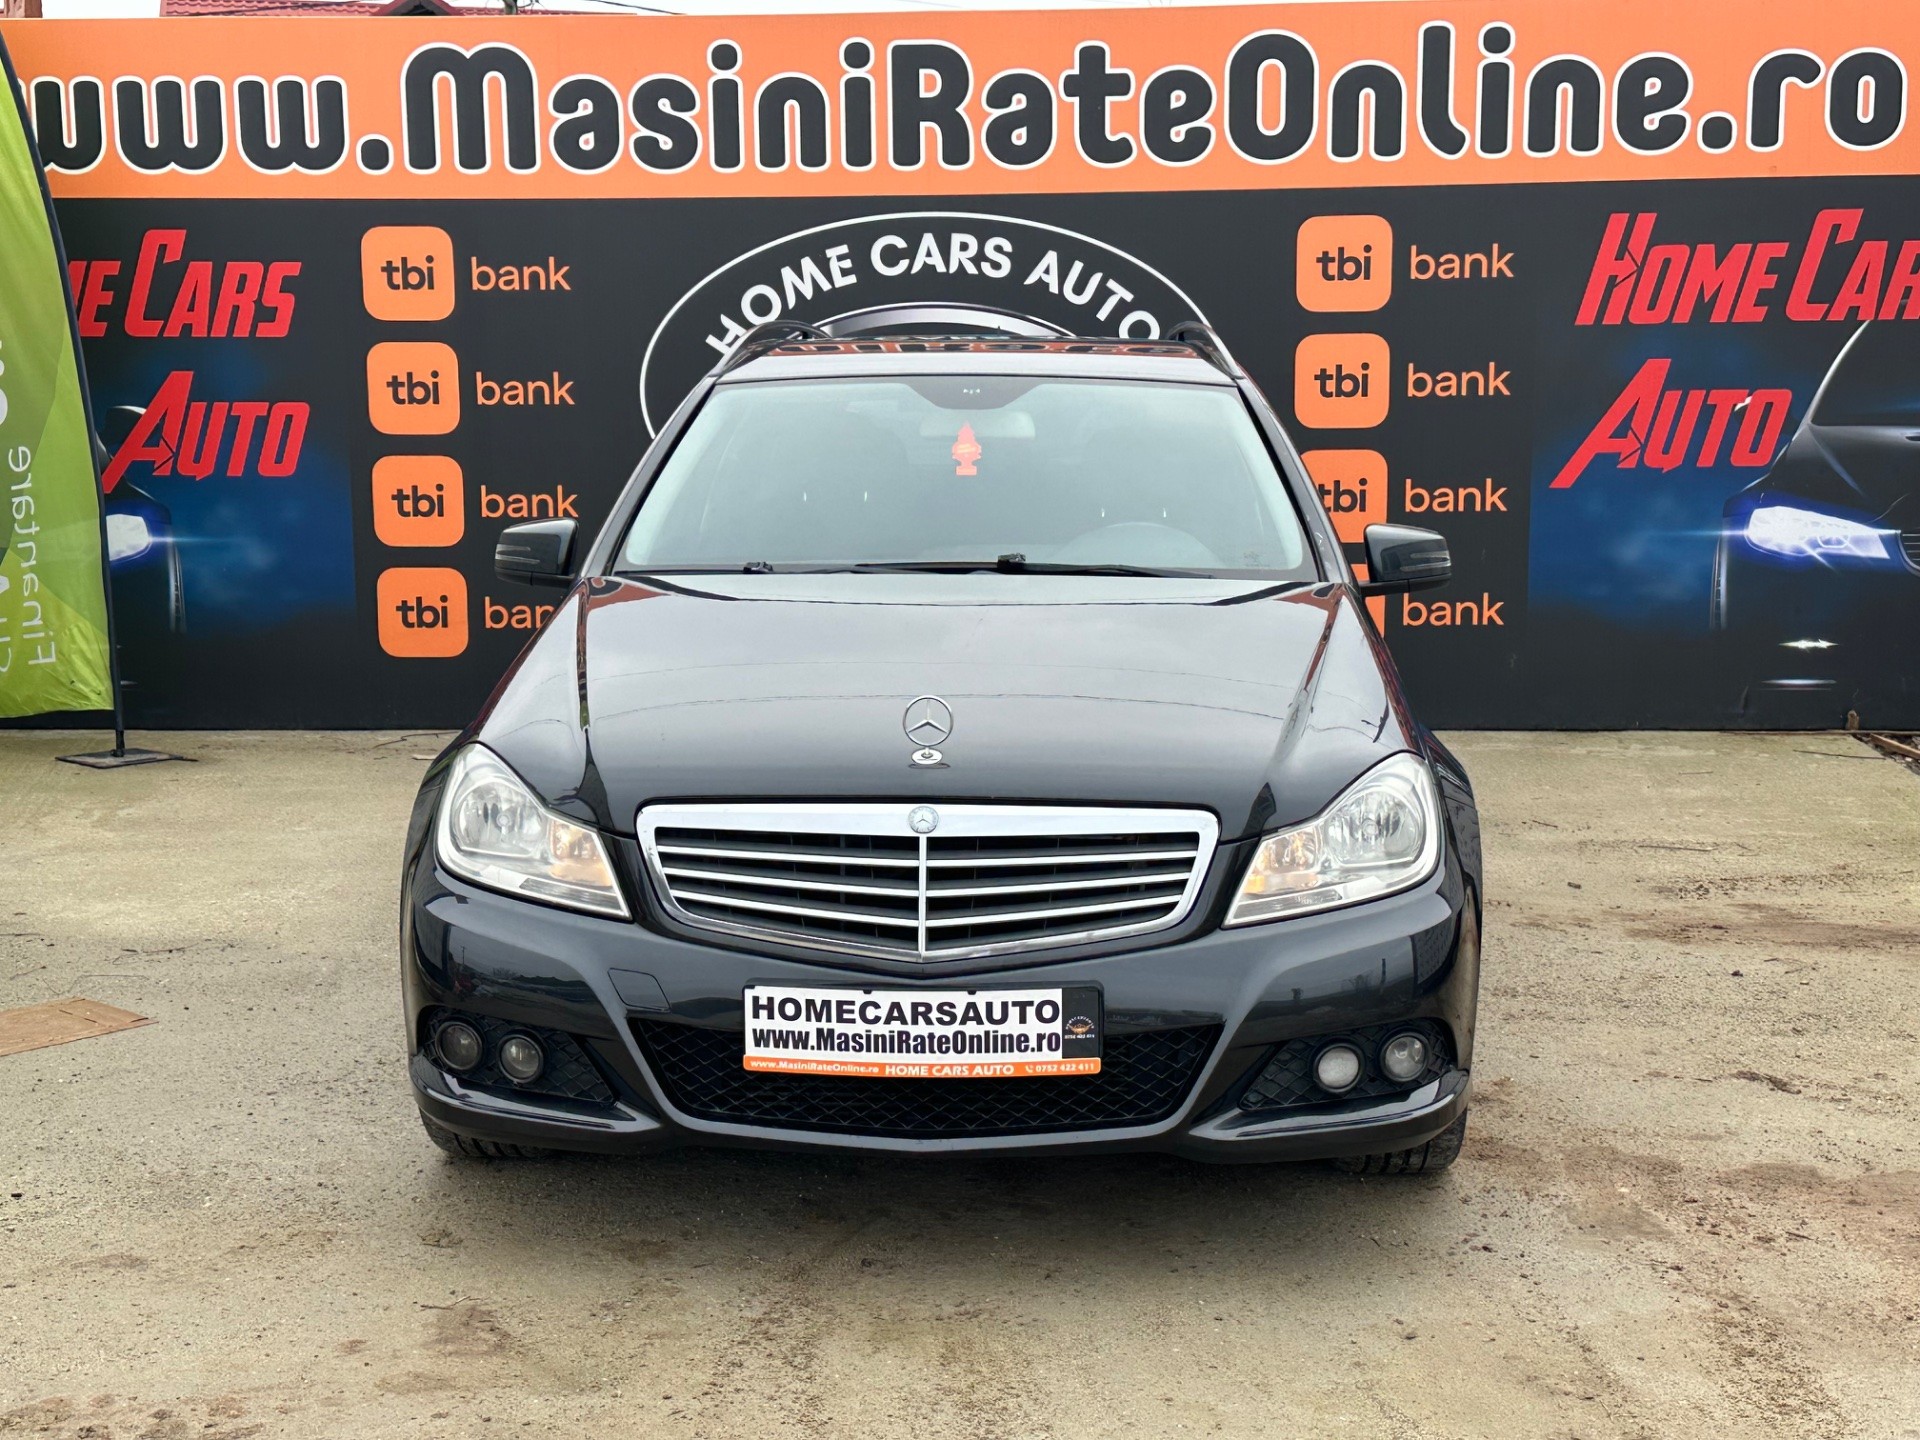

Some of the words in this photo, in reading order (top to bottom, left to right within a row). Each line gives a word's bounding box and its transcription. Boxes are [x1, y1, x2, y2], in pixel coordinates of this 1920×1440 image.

[381, 255, 435, 290] tbi
[471, 256, 571, 291] bank
[1316, 244, 1372, 281] tbi
[1410, 244, 1514, 280] bank
[1575, 212, 1789, 326] HOME
[1785, 208, 1920, 322] CAR
[124, 229, 302, 338] CARS
[706, 244, 858, 355] HOME
[870, 232, 1013, 278] CARS
[1023, 250, 1161, 340] AUTO
[386, 370, 440, 405] tbi
[475, 371, 575, 406] bank
[1314, 362, 1370, 398] tbi
[1407, 362, 1511, 398] bank
[103, 371, 310, 493] AUTO
[1549, 358, 1792, 488] AUTO
[391, 483, 444, 518] tbi
[480, 484, 579, 518] bank
[1405, 478, 1507, 513] bank
[395, 595, 449, 629] tbi
[484, 596, 556, 629] ban
[1402, 593, 1505, 627] bank
[752, 995, 1060, 1025] HOMECARSAUTO
[752, 1028, 1060, 1054] www.MasiniRateOnline.ro
[884, 1064, 928, 1077] HOME
[931, 1064, 969, 1077] CARS
[972, 1063, 1015, 1076] AUTO
[1060, 1063, 1077, 1072] 422
